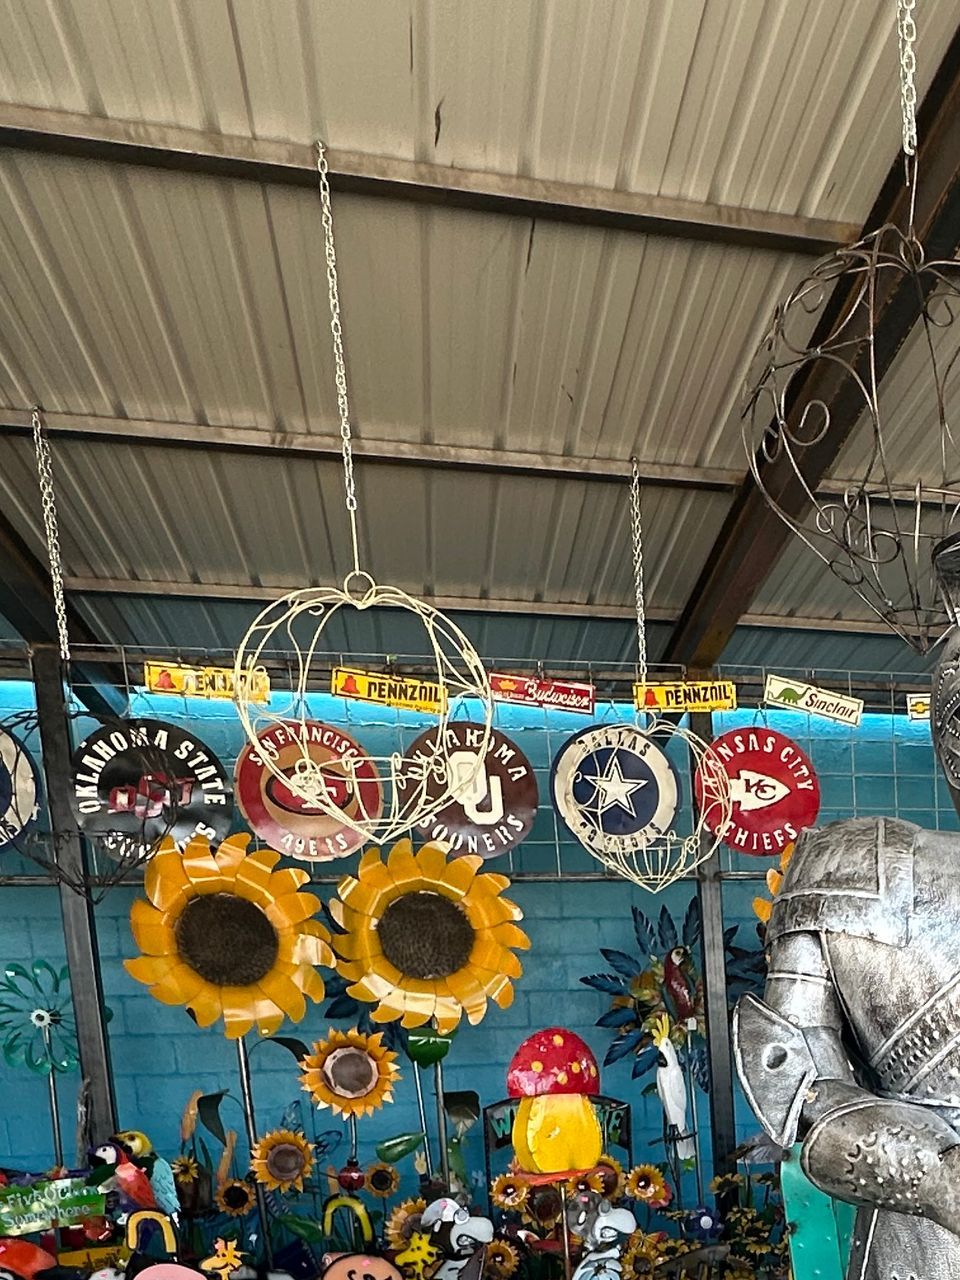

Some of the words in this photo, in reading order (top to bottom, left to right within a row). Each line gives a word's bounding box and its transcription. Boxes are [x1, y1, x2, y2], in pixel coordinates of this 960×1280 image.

[367, 681, 441, 703] PENNZOIL
[525, 681, 590, 708] Budweiser
[665, 684, 730, 706] PENNZOIL
[805, 692, 857, 719] Sinclair
[75, 726, 169, 814] OKLAHOMA
[173, 739, 227, 806] STATE
[780, 746, 814, 791] CITY
[419, 813, 525, 854] SOONERS
[716, 820, 798, 851] CHIEFS
